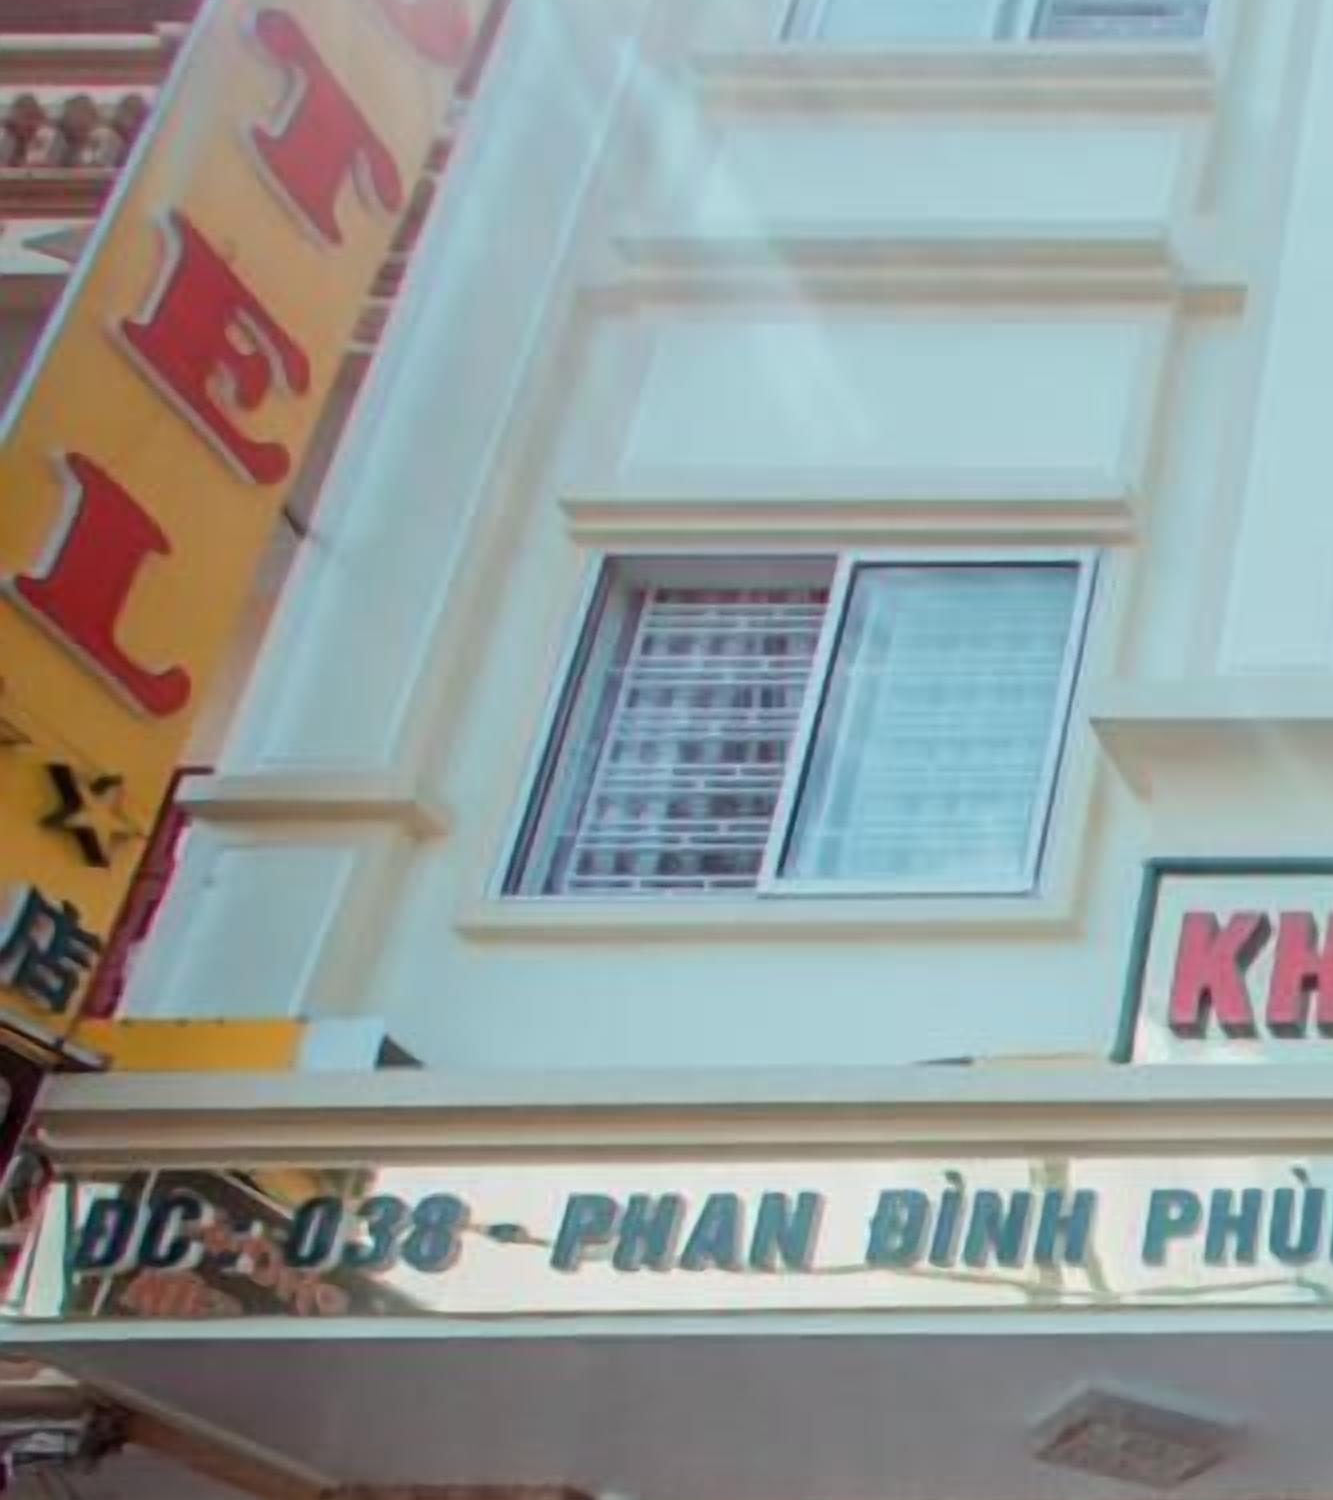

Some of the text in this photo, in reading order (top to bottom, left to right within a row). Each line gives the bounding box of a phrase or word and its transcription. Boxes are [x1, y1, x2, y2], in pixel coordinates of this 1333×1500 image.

[286, 1191, 472, 1273] 038
[550, 1189, 829, 1273] PHAN
[865, 1167, 1098, 1269] ĐÌNH
